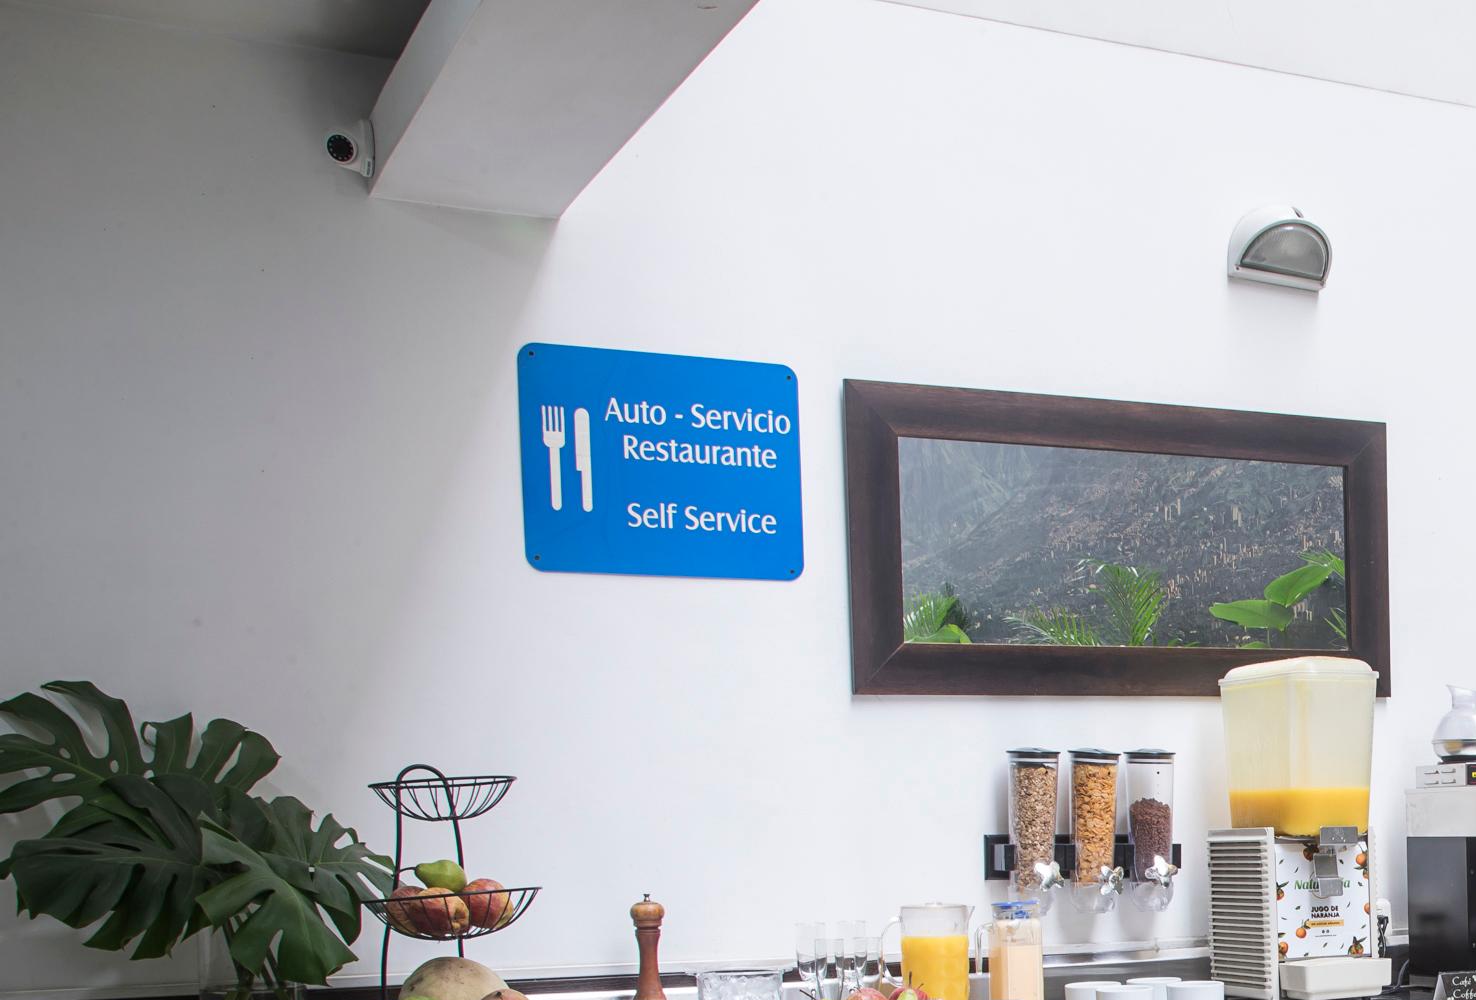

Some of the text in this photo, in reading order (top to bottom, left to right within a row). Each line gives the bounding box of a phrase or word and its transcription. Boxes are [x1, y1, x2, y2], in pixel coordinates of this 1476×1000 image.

[604, 397, 667, 426] Auto
[690, 403, 792, 435] Servicio
[623, 435, 778, 470] Restaurante
[627, 502, 778, 535] Self Service
[1311, 905, 1329, 913] JUGO
[1452, 976, 1472, 987] Café
